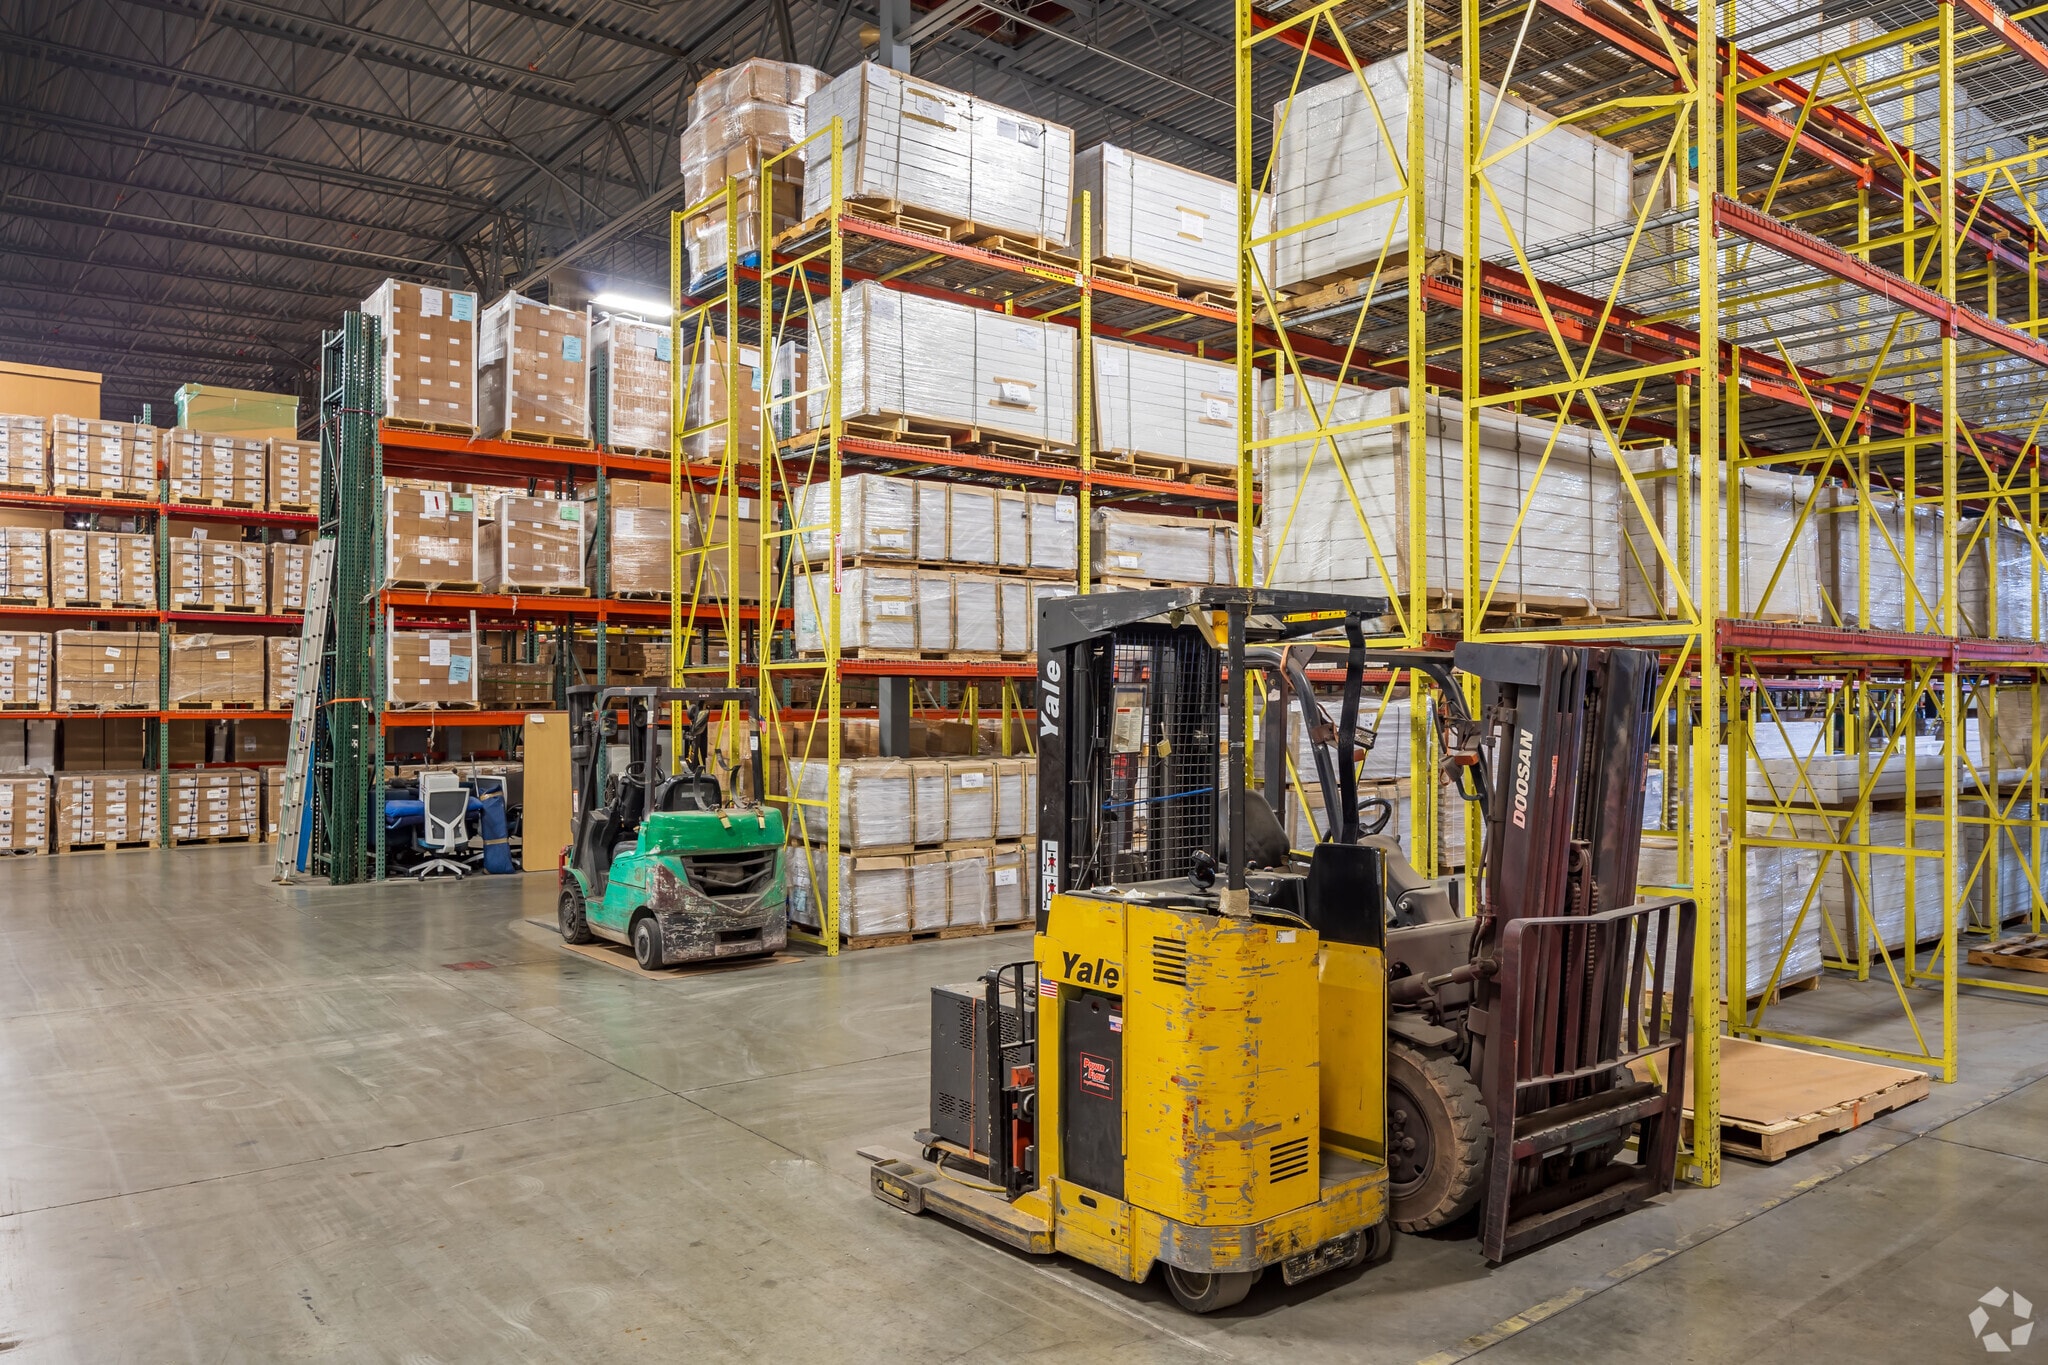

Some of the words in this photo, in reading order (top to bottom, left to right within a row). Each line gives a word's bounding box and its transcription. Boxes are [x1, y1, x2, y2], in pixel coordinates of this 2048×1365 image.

[1040, 661, 1061, 737] Yale
[1512, 729, 1535, 830] DOOSAN
[1062, 951, 1120, 989] Yale
